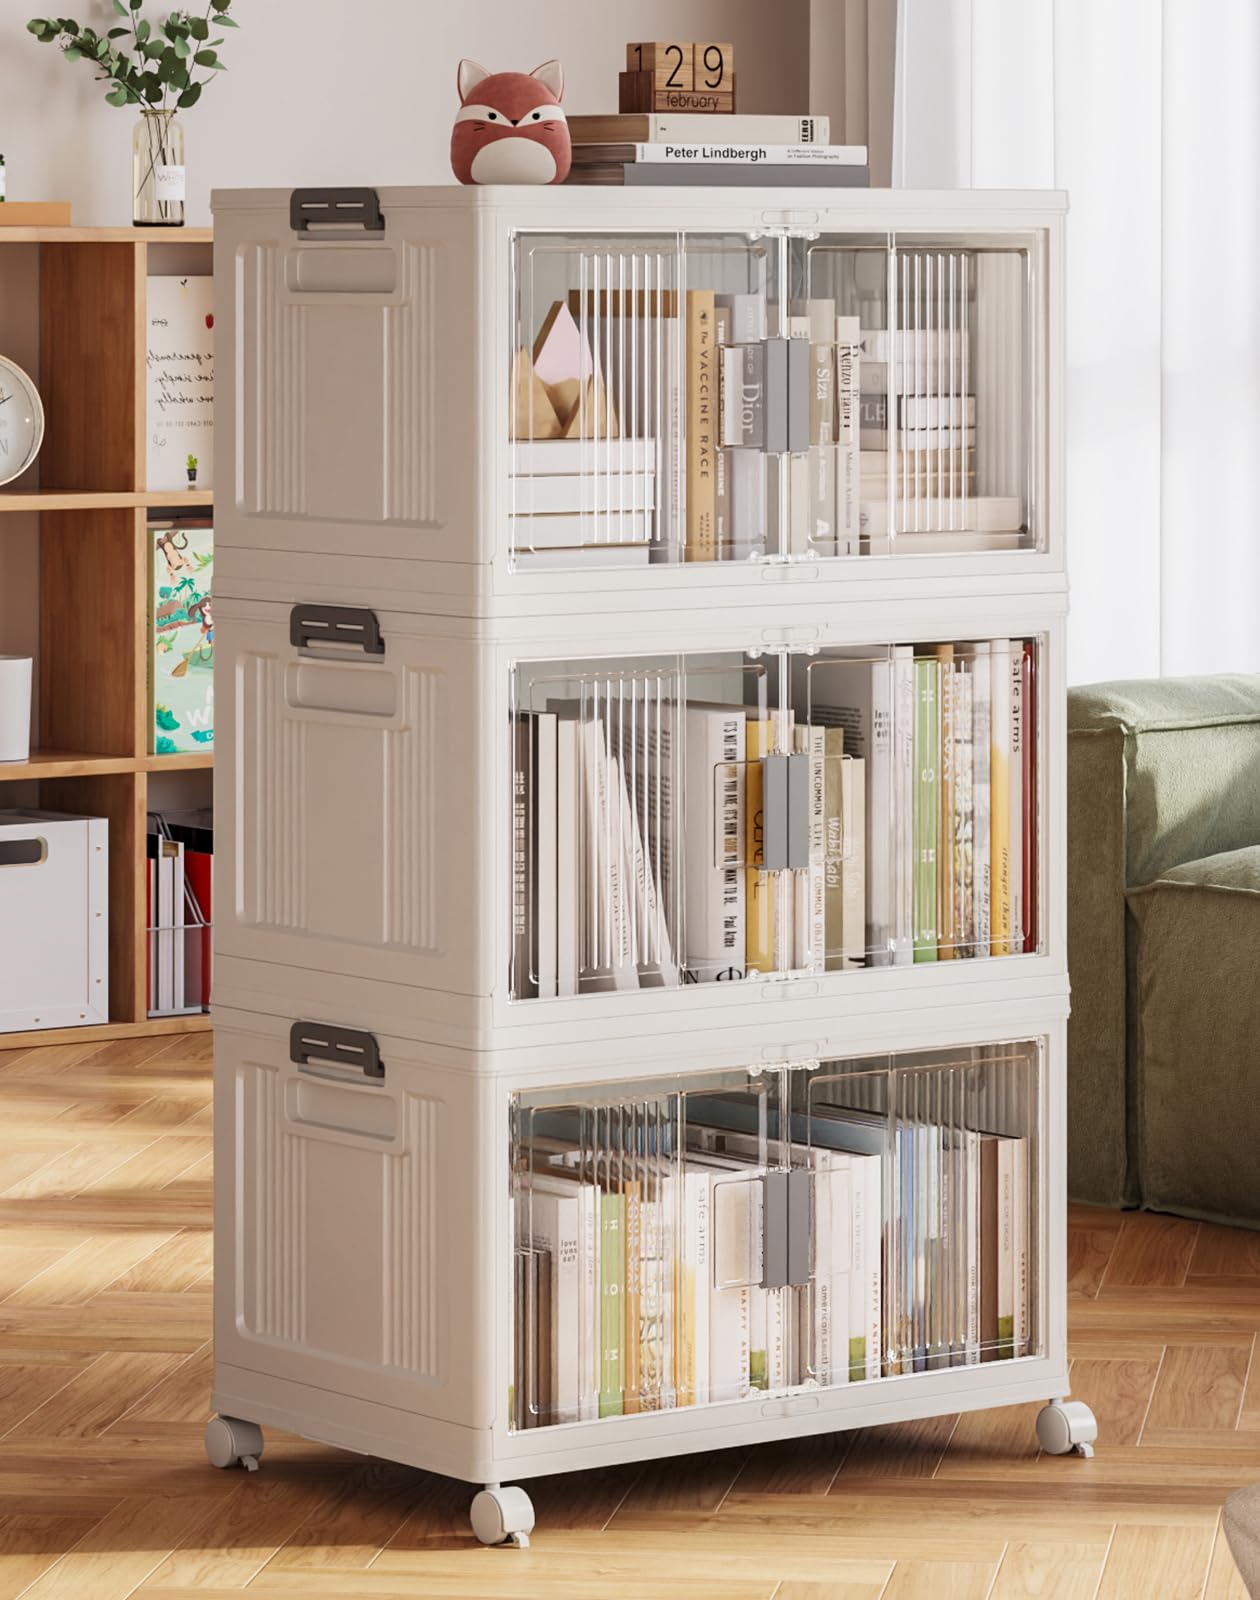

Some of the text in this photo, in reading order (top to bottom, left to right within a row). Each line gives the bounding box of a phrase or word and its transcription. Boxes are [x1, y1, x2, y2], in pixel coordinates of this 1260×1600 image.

[666, 91, 719, 111] february
[665, 146, 767, 162] Peter Lindbergh
[700, 350, 709, 425] VACCINE
[742, 383, 762, 434] Dior
[700, 435, 709, 479] RACE
[1012, 658, 1023, 753] safe arms
[814, 735, 823, 754] THE
[814, 761, 823, 816] UNCOMMON
